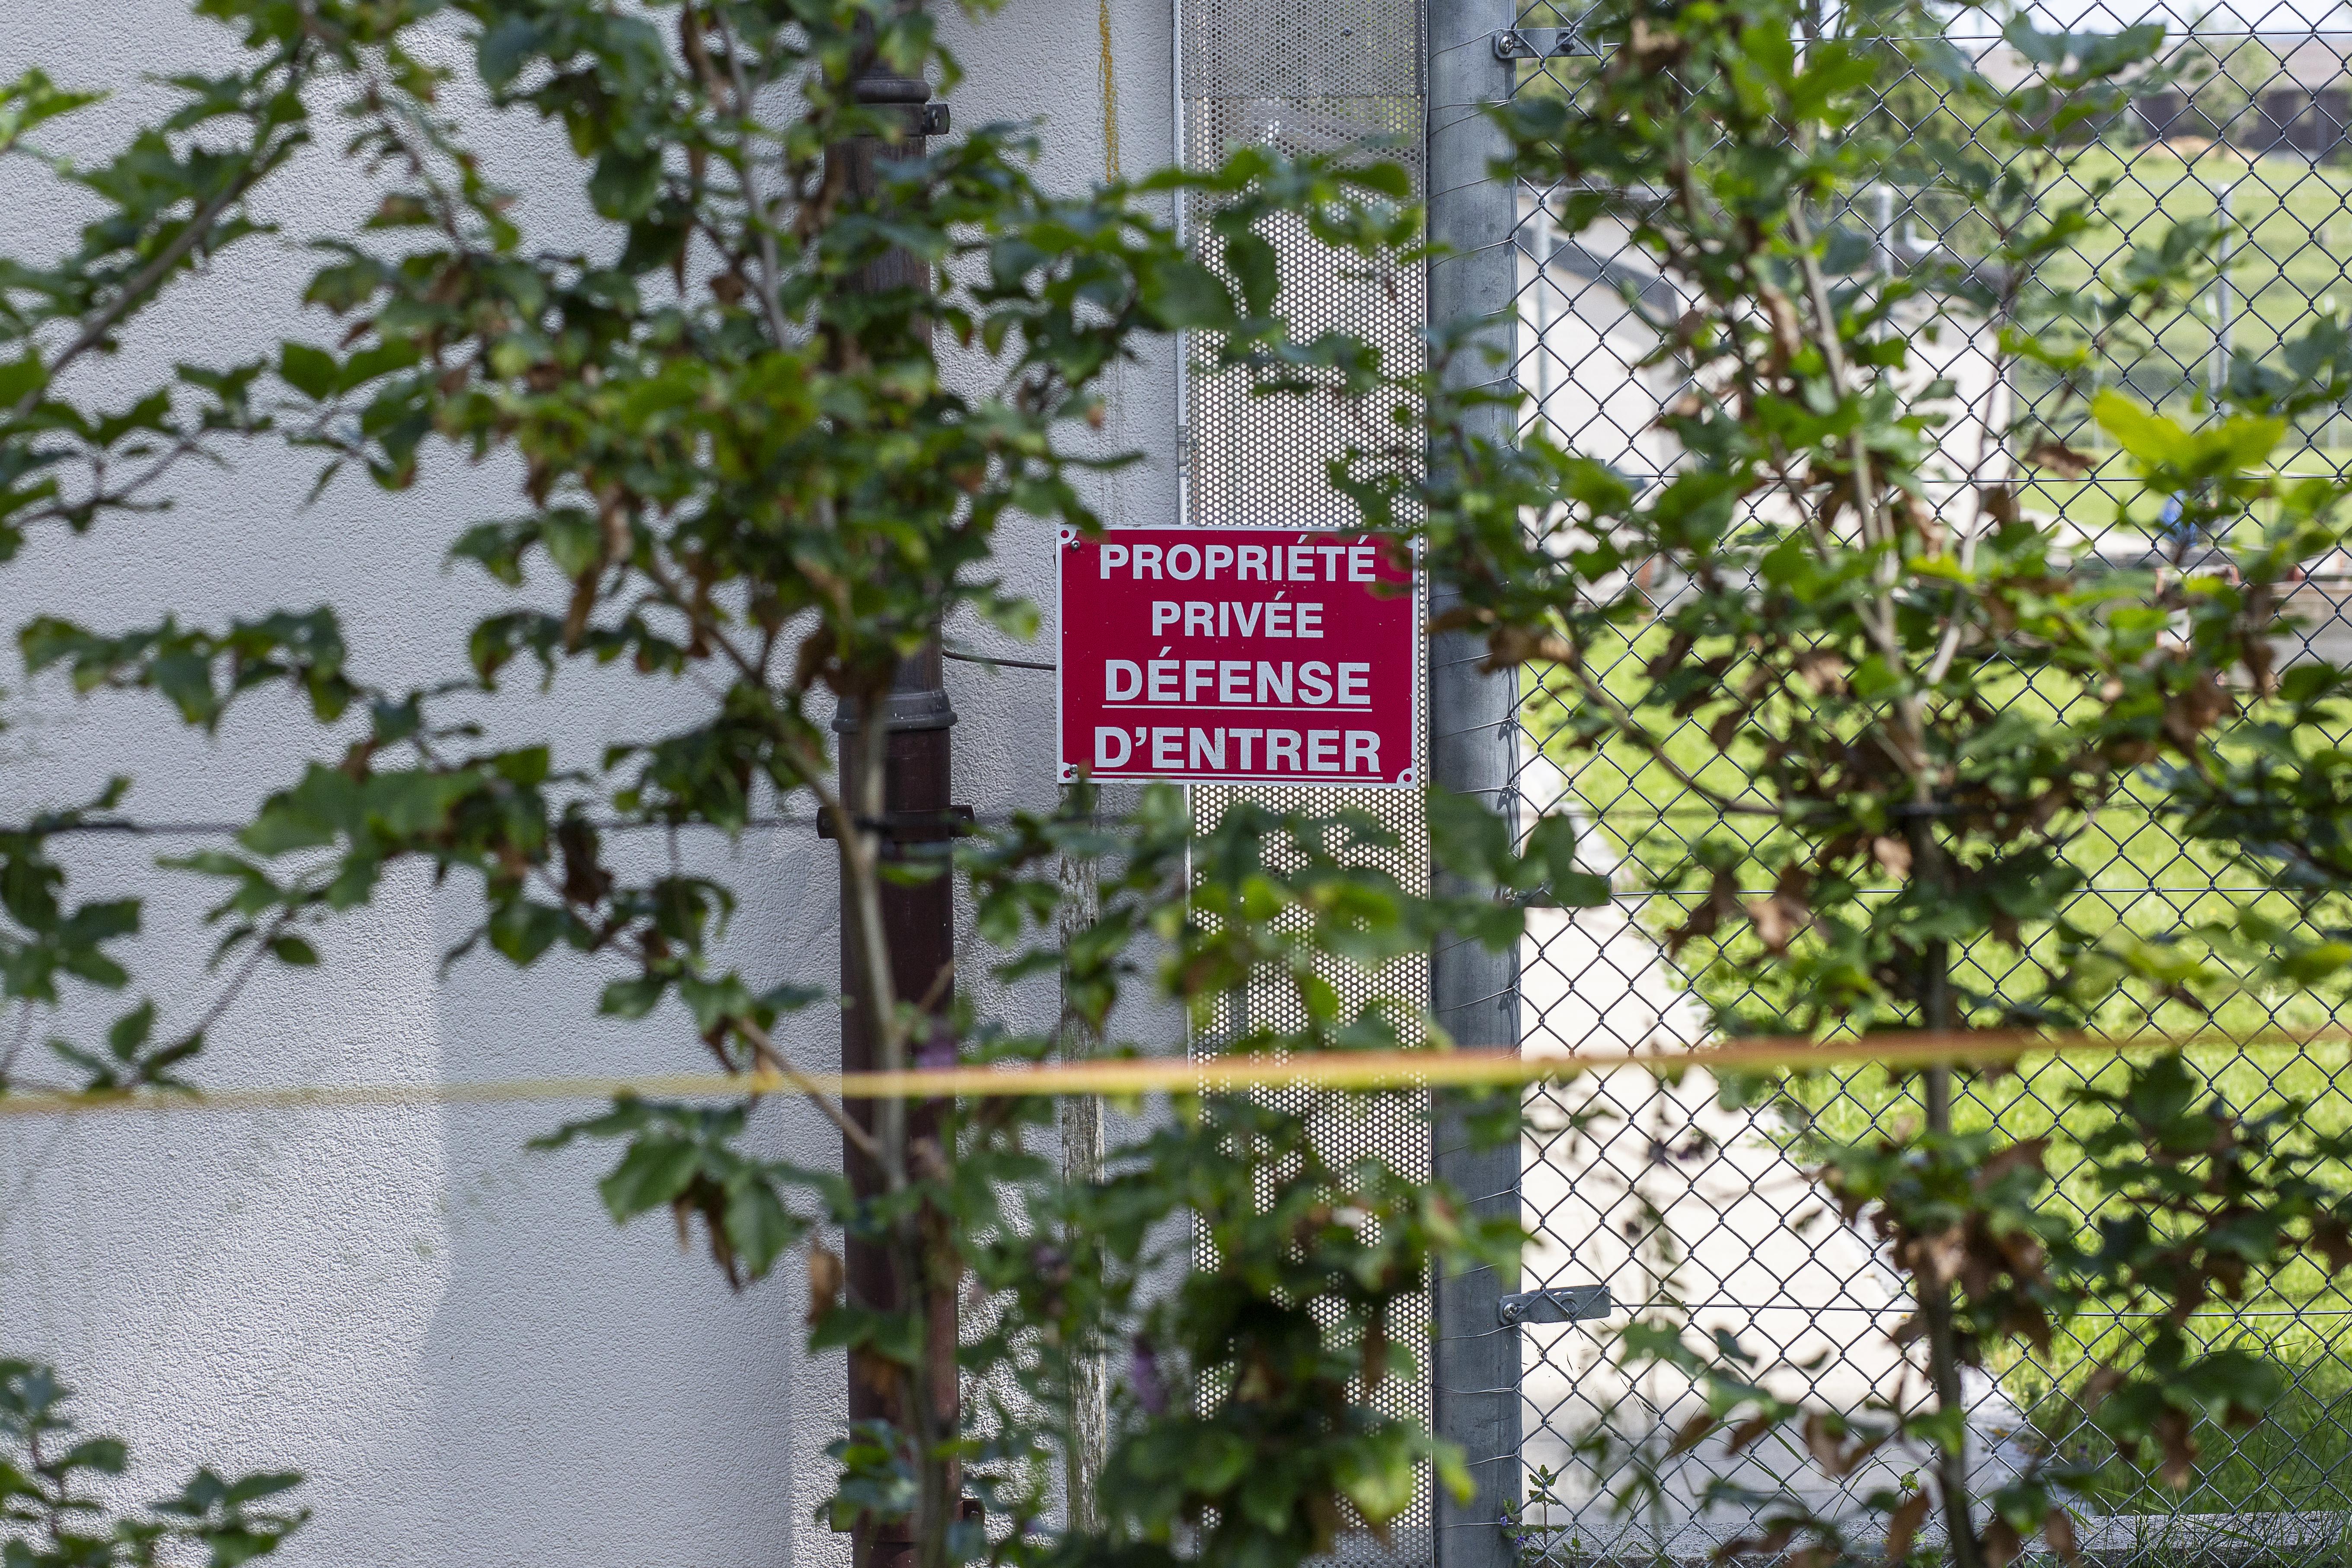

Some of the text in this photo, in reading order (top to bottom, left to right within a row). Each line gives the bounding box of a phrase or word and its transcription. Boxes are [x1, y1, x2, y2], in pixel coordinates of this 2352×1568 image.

[1101, 535, 1375, 581] PROPRIÉTÉ
[1152, 591, 1324, 638] PRIVÉE
[1106, 647, 1370, 705] DÉFENSE
[1095, 727, 1381, 772] D’ENTRER
